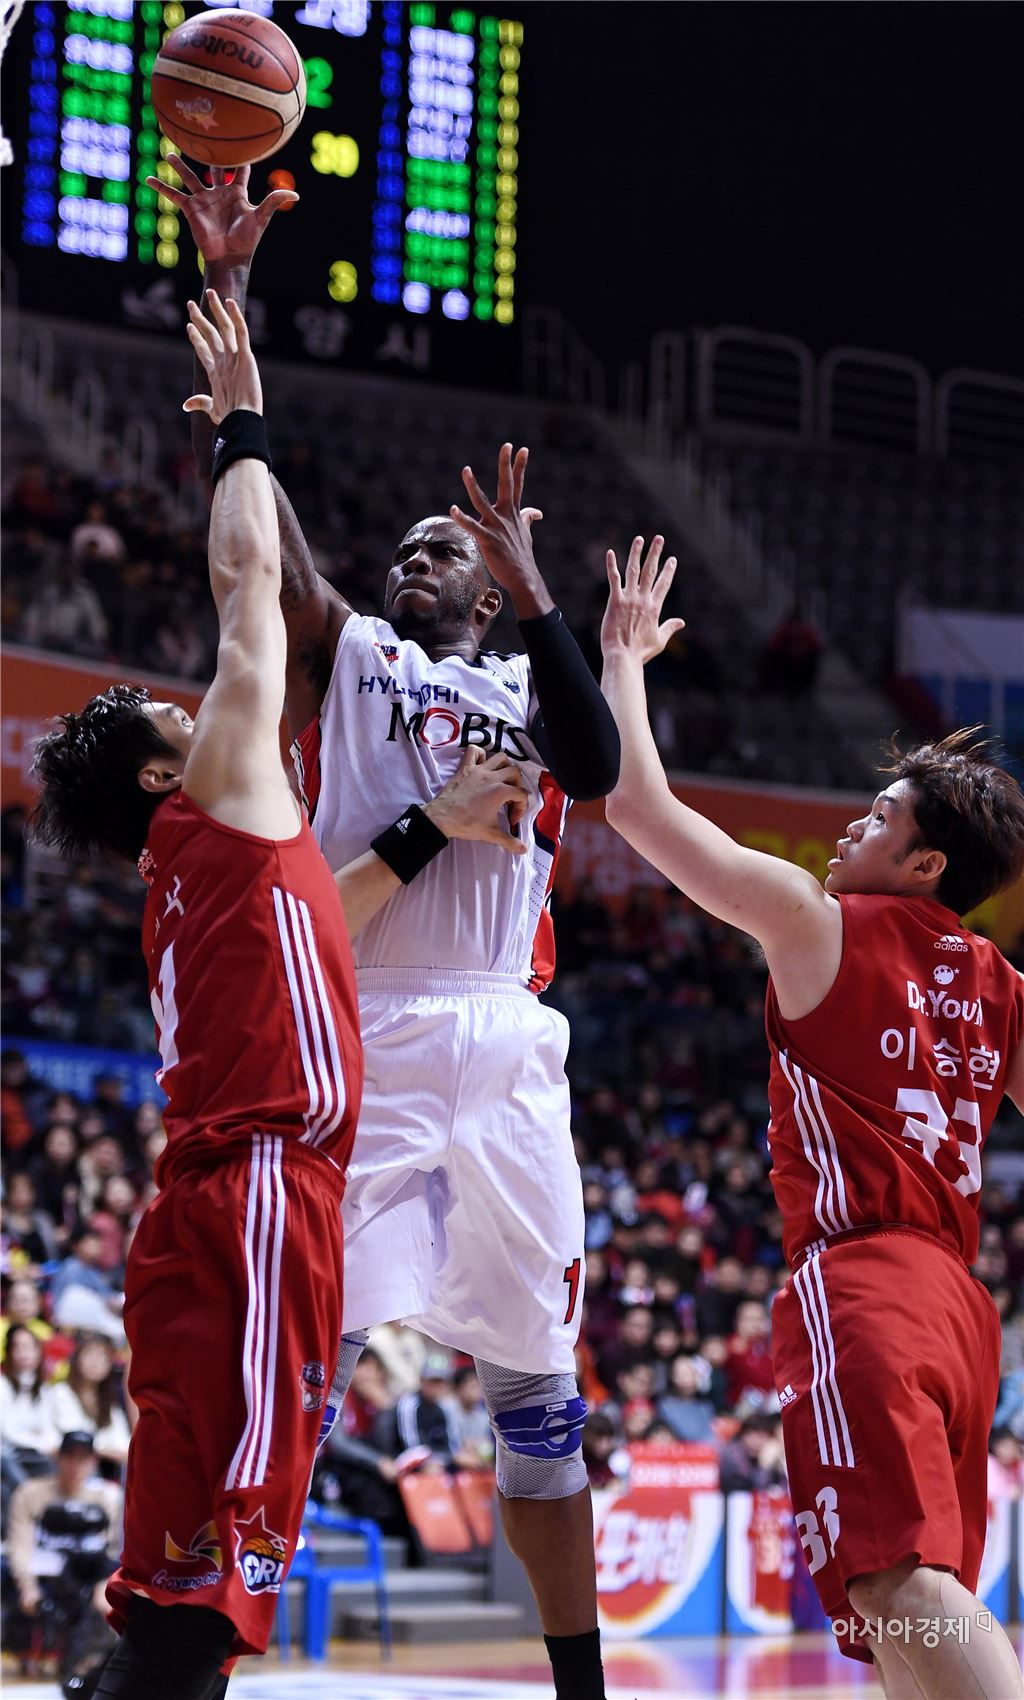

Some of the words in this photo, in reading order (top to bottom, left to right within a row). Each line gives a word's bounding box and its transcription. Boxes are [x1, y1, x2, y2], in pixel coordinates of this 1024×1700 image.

[386, 702, 530, 762] MOBIS
[933, 940, 969, 953] adidas
[880, 1026, 1000, 1091] 이승현
